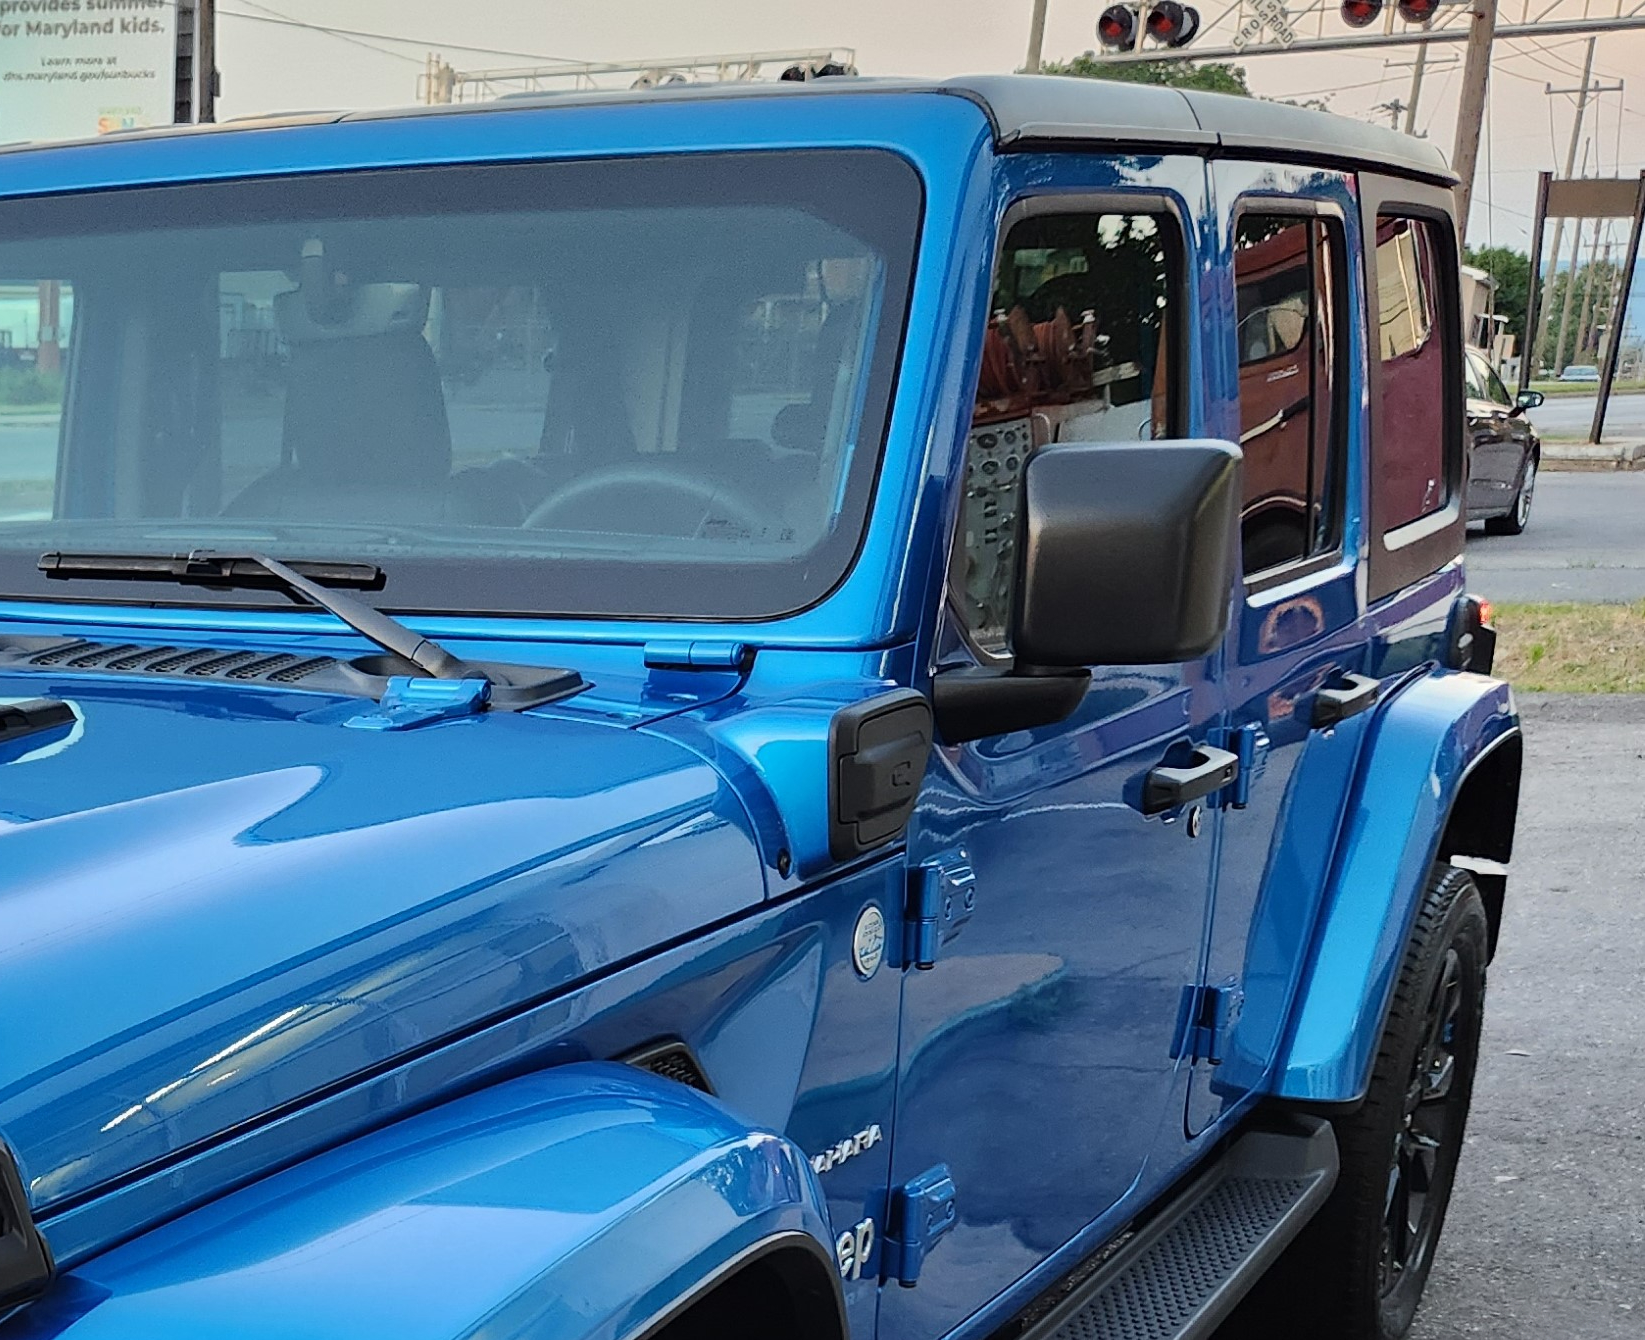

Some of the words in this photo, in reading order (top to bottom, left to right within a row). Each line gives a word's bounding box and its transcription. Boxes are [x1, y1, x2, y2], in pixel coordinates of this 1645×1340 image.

[25, 17, 114, 39] Maryland
[120, 16, 165, 34] kids.
[1233, 0, 1282, 47] CROSS
[41, 56, 72, 67] Learn
[74, 57, 103, 66] more
[106, 56, 117, 65] at
[809, 1124, 883, 1175] AHARA
[835, 1217, 875, 1281] ep
